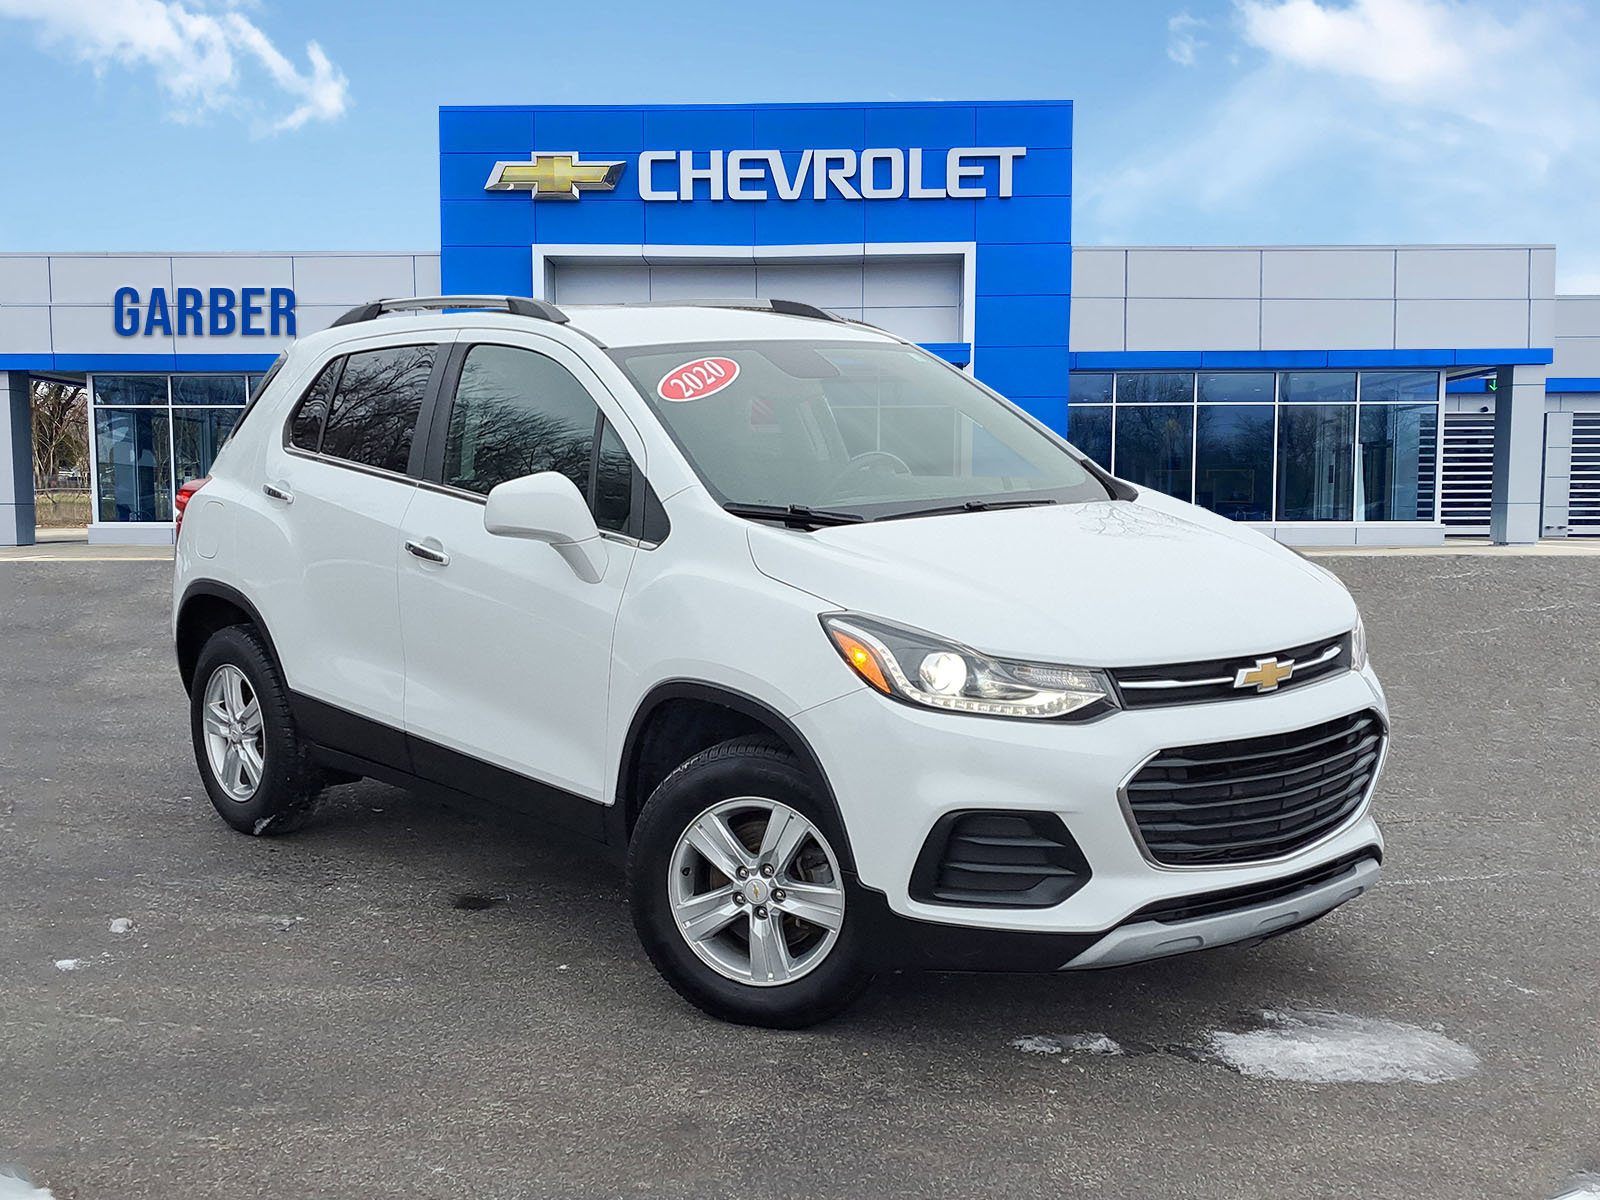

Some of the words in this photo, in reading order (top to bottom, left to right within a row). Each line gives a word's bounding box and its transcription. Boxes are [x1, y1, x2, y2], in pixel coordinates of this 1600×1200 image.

[638, 147, 1027, 201] CHEVROLET
[113, 286, 297, 337] GARBER
[670, 360, 726, 398] 2020
